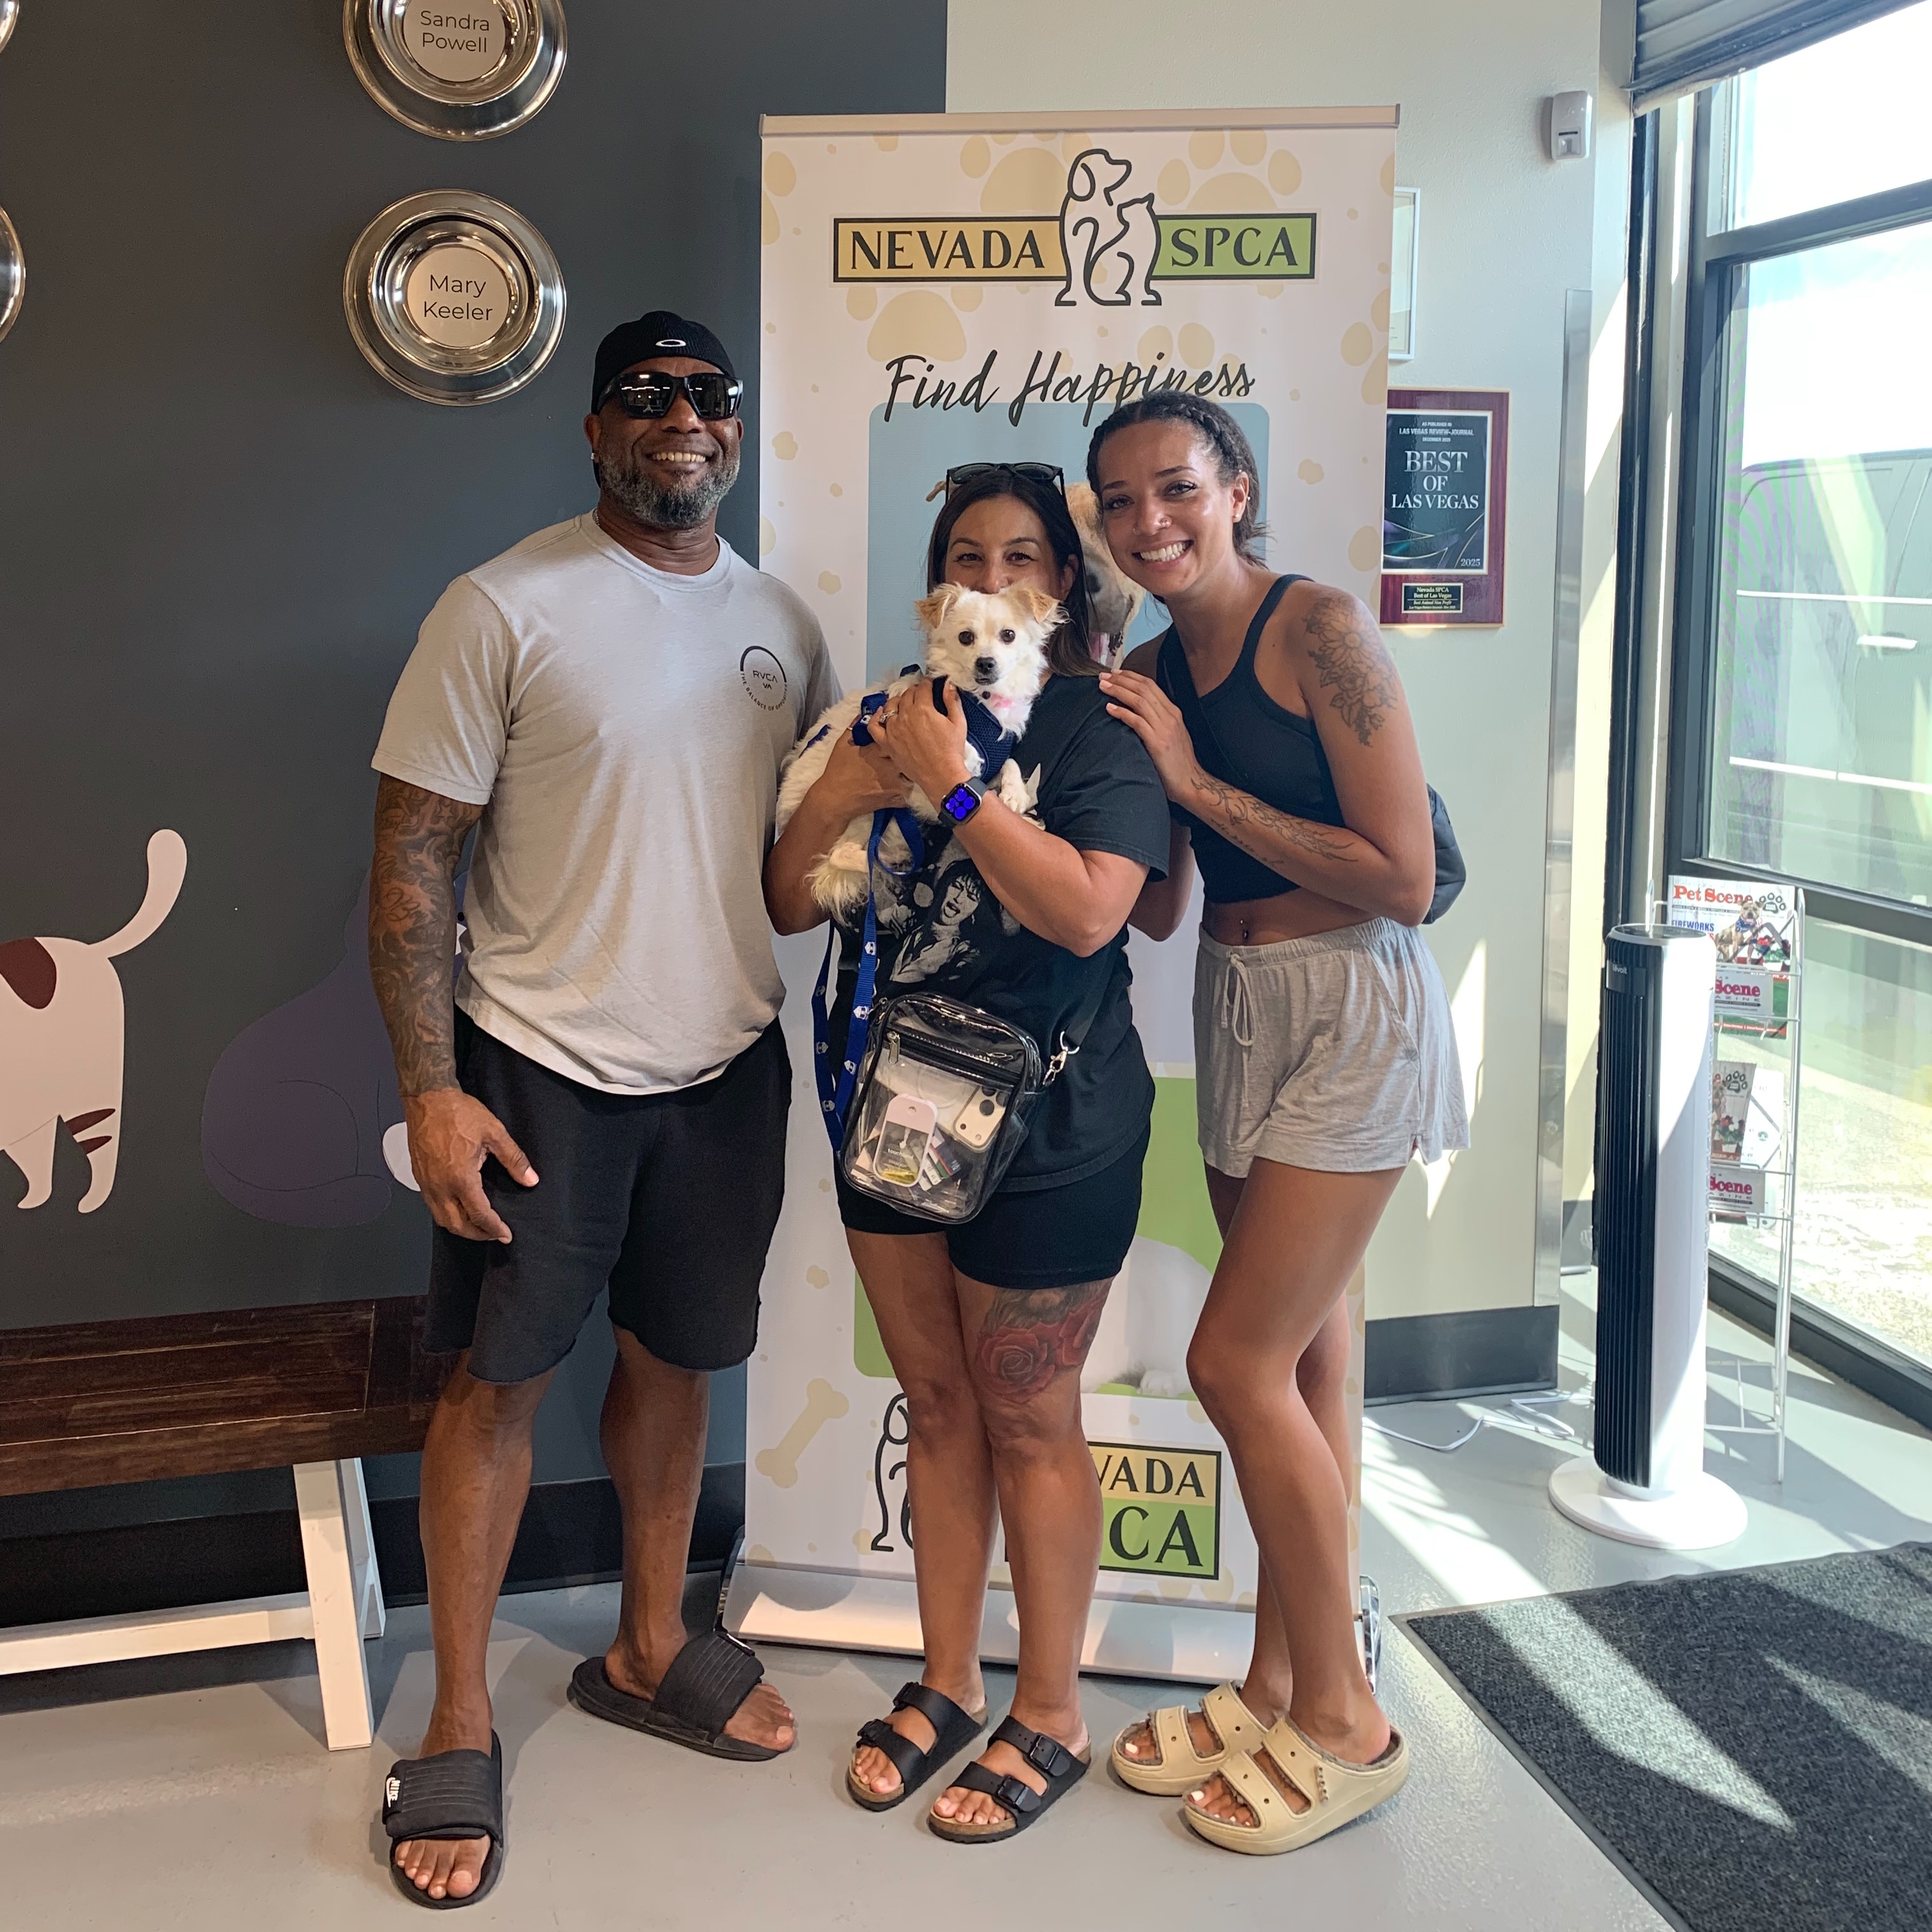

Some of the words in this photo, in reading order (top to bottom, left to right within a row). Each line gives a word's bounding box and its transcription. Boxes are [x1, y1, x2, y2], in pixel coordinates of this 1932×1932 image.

[420, 10, 490, 32] Sandra
[422, 33, 487, 53] Powell
[851, 229, 1045, 270] NEVADA
[1171, 227, 1298, 267] SPCA
[429, 274, 486, 298] Mary
[423, 302, 493, 321] Keeler
[884, 349, 1000, 422] Find
[1008, 349, 1255, 427] Happiness
[1404, 450, 1468, 473] BEST
[1423, 475, 1448, 491] OF
[1391, 494, 1422, 509] LAS
[1424, 494, 1479, 509] VEGAS
[1460, 558, 1480, 567] 2025
[753, 670, 778, 684] RVCA
[746, 687, 767, 710] BALANCE
[1673, 885, 1701, 902] Pet
[1704, 887, 1753, 905] Scene
[1090, 1453, 1206, 1498] VADA
[1108, 1506, 1204, 1567] CA
[390, 1779, 401, 1802] NIKE
